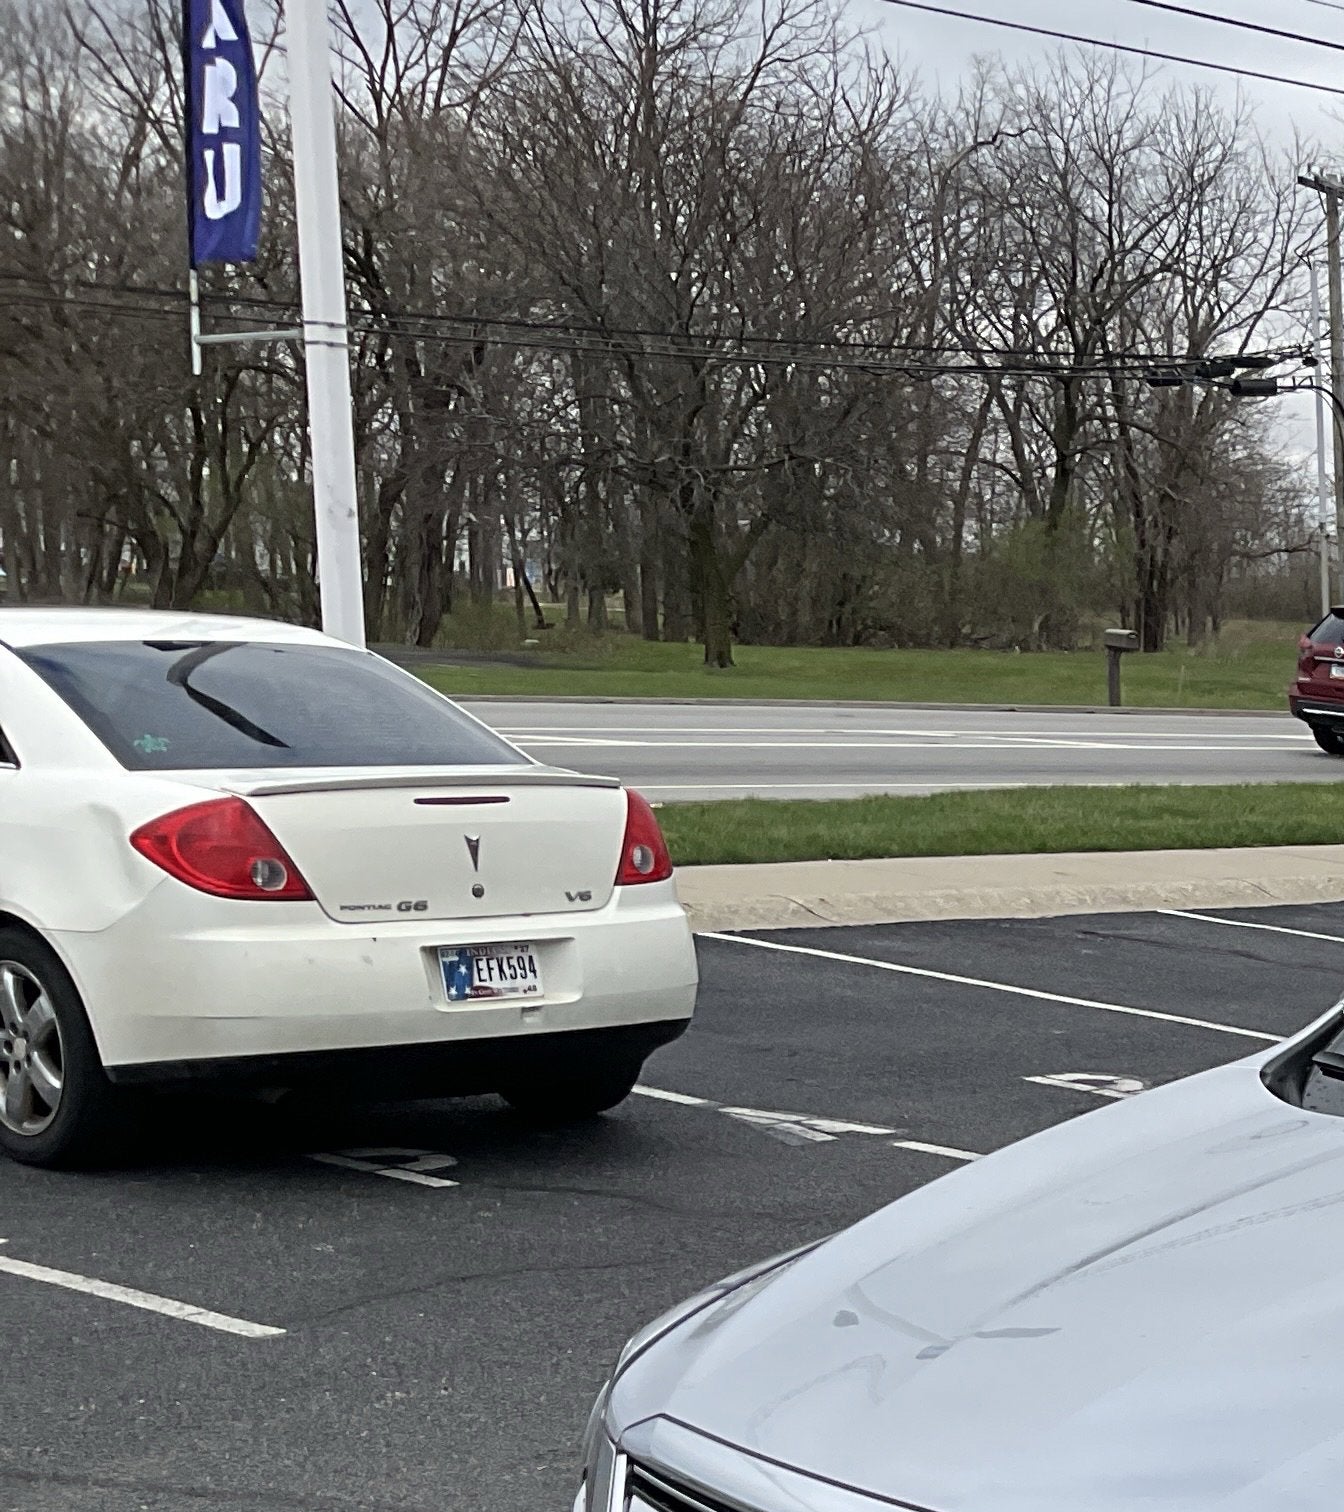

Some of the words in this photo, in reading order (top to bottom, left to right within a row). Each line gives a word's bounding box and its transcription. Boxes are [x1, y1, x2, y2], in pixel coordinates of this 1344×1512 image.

[564, 890, 592, 902] V6
[339, 903, 393, 912] PONTIAC
[397, 900, 428, 913] G6
[475, 955, 538, 983] EFK594
